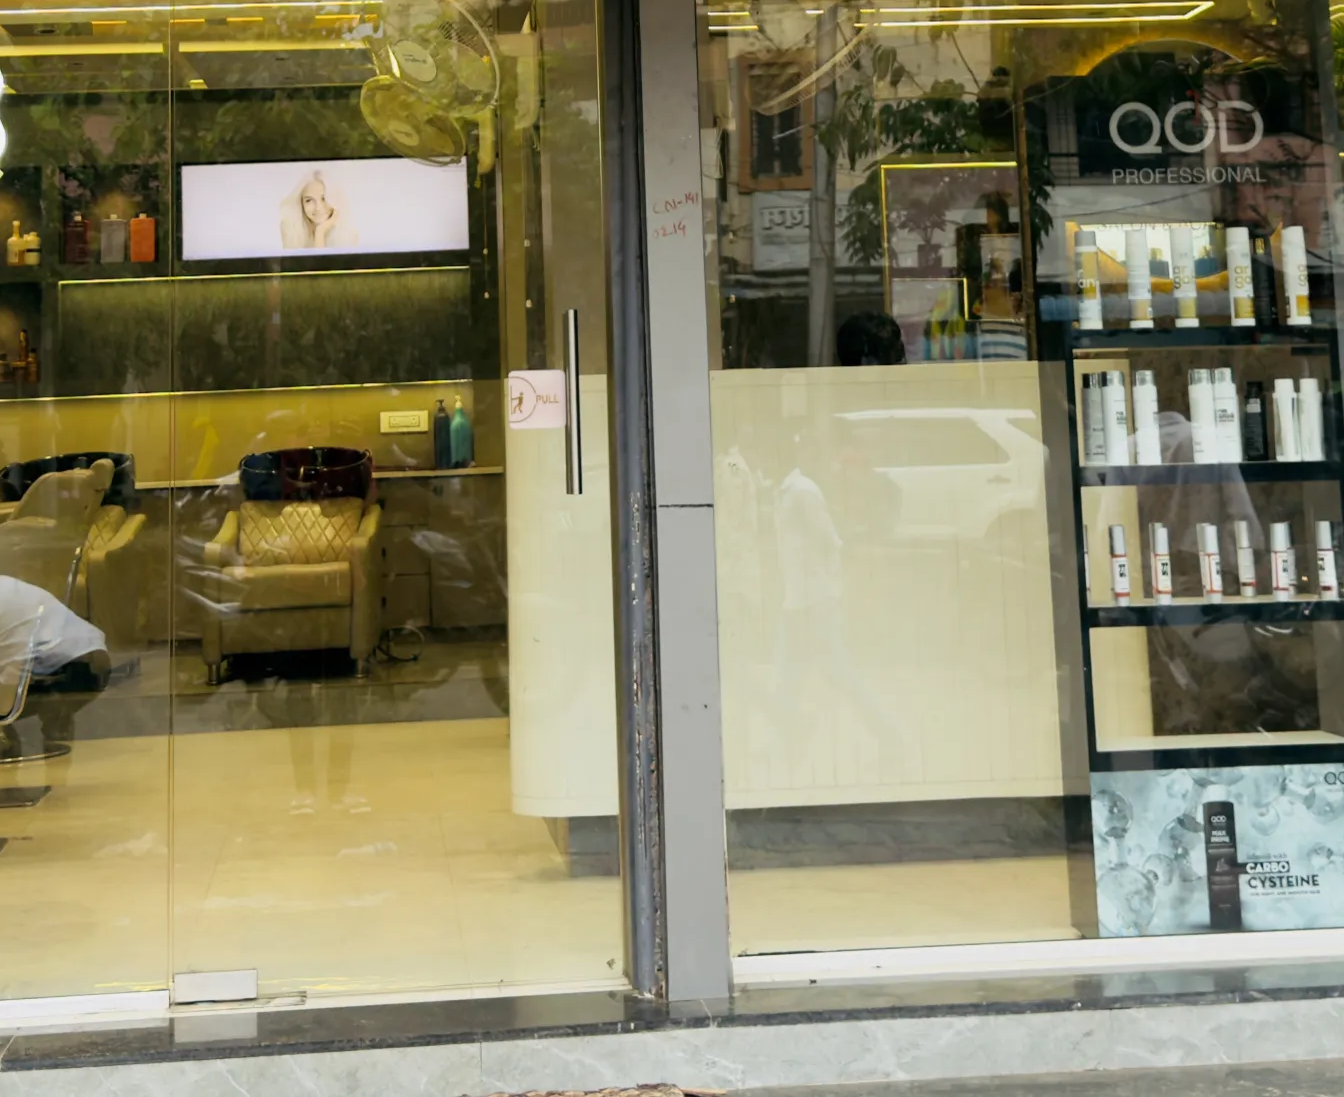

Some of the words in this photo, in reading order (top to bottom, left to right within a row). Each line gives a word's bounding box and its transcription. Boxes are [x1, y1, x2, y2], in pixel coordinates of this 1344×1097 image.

[1109, 101, 1265, 154] QOD
[1111, 166, 1268, 185] PROFESSIONAL
[535, 392, 560, 405] PULL
[1245, 861, 1290, 874] CARBO
[1247, 874, 1321, 890] CYSTEINE
